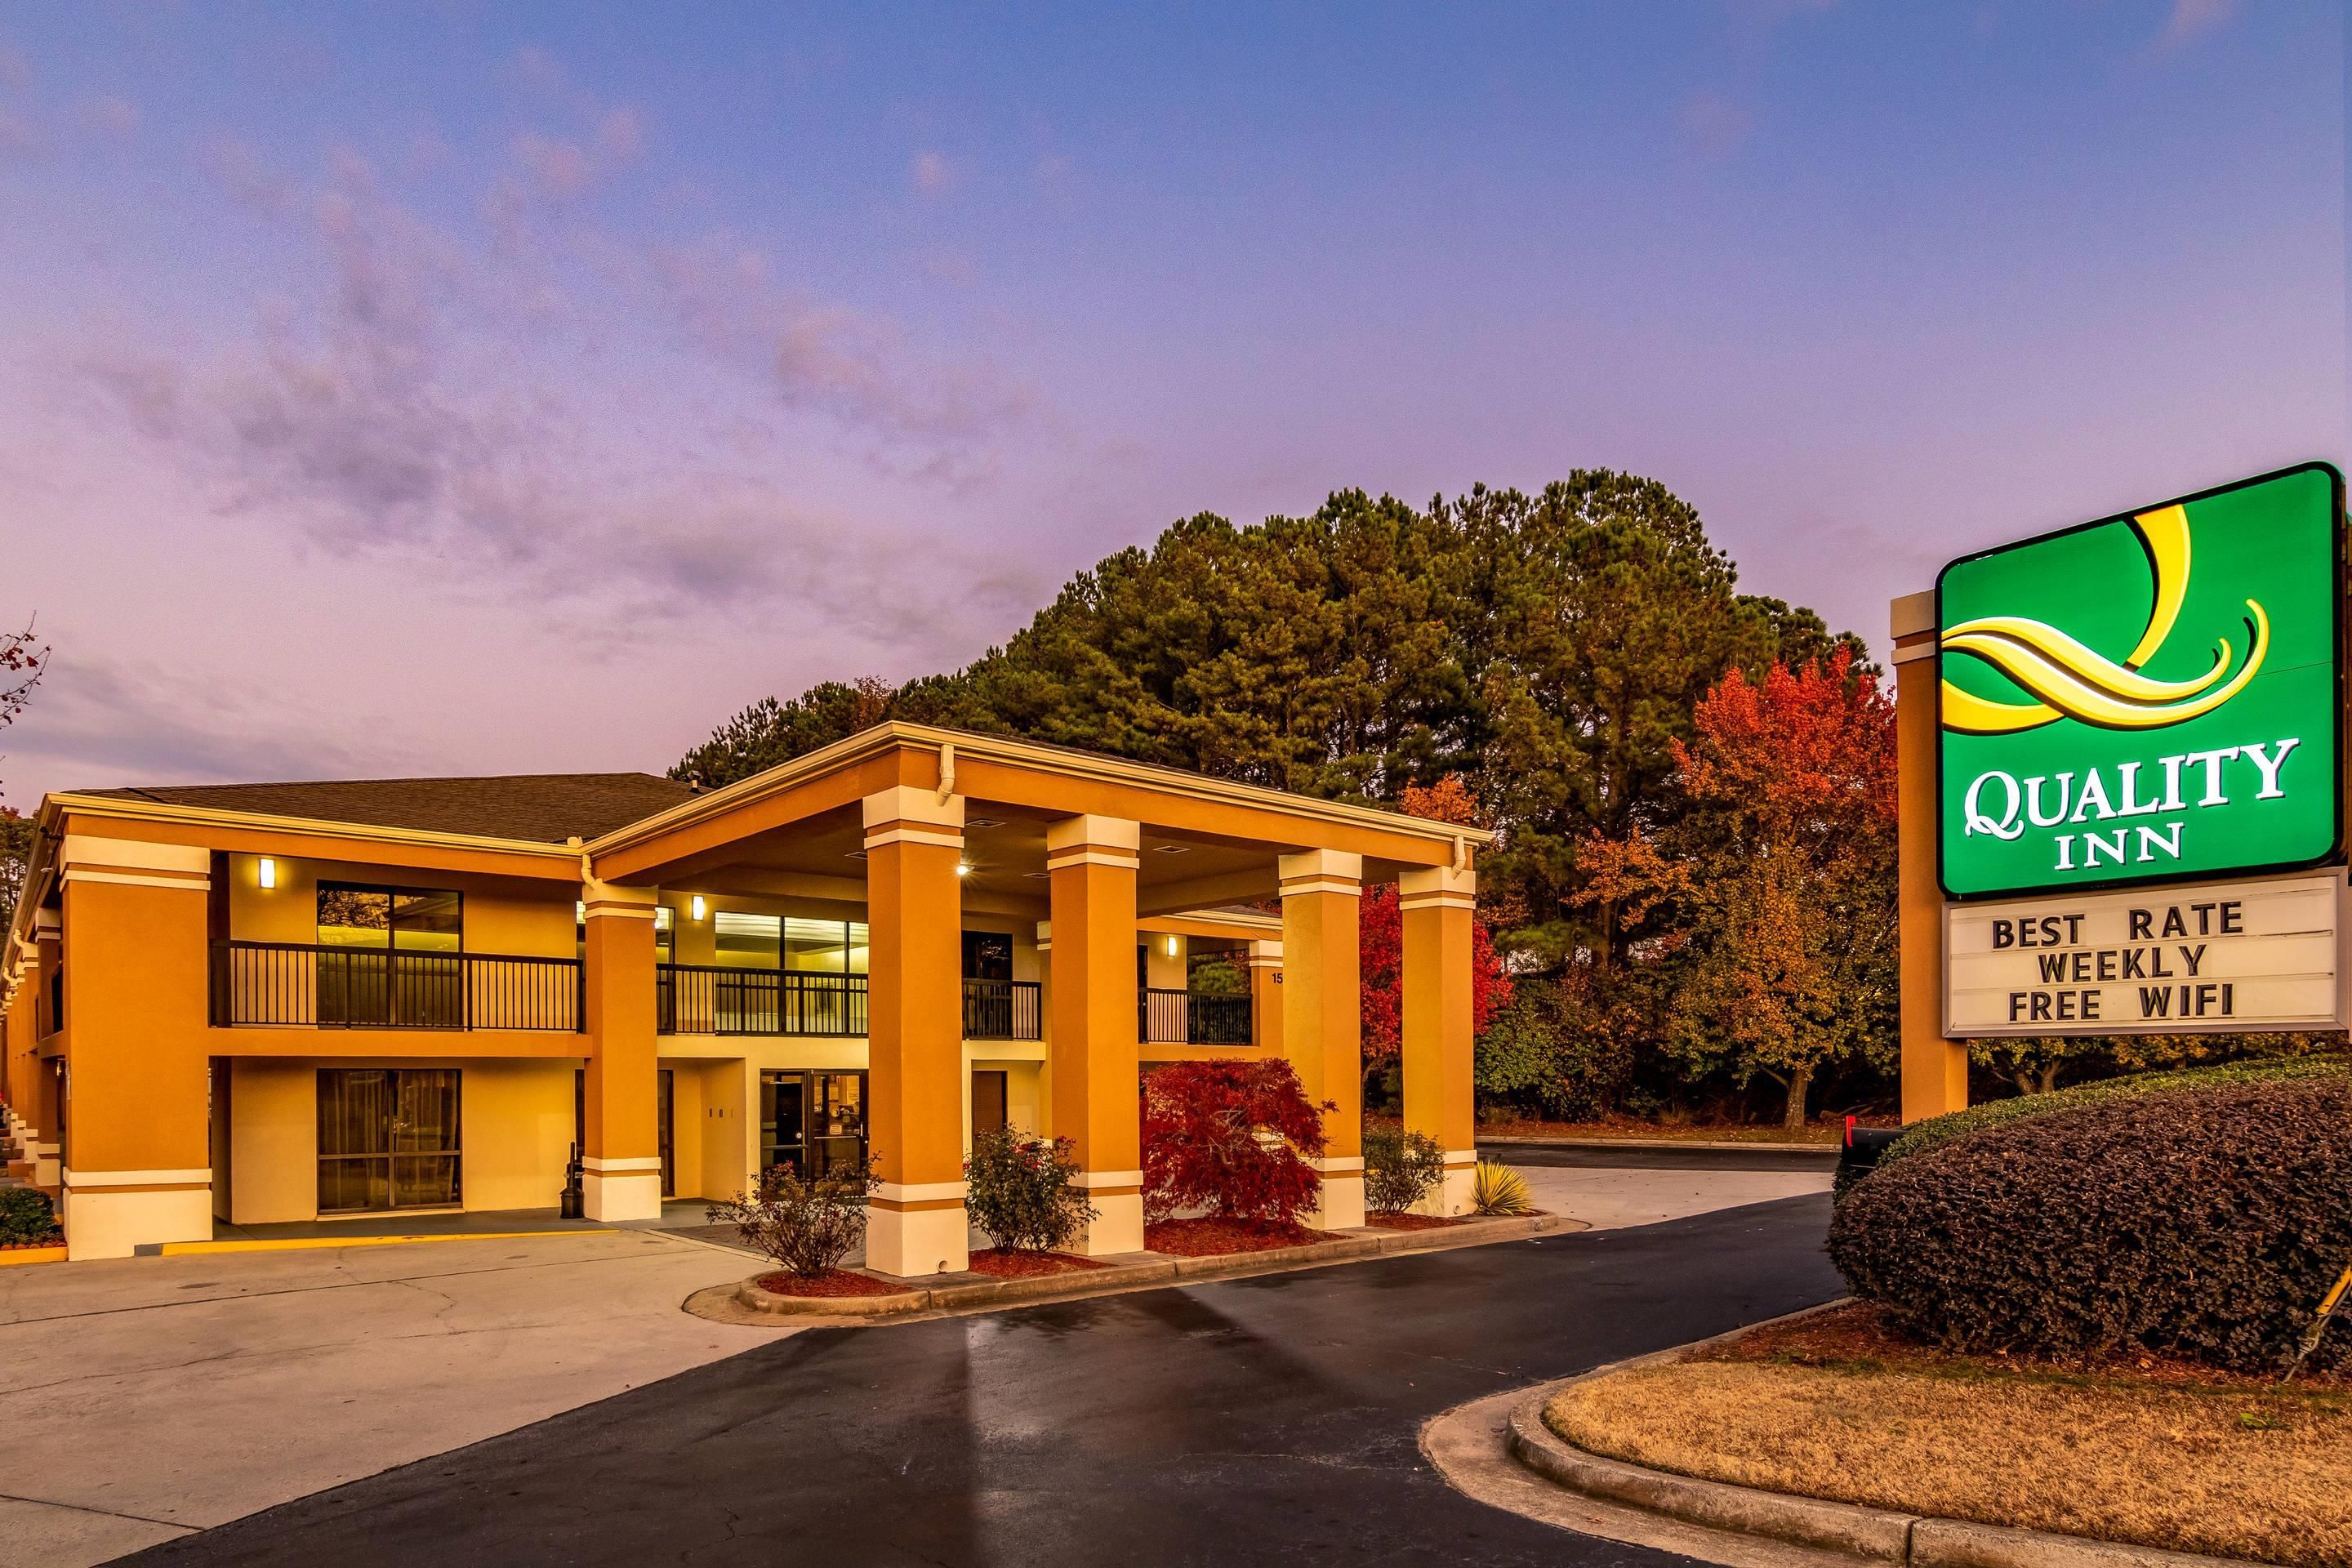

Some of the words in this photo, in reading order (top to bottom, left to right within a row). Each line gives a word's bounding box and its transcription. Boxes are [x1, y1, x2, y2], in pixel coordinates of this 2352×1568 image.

[1964, 738, 2301, 841] QUALITY
[2054, 822, 2186, 871] INN
[1992, 914, 2085, 949] BEST
[2129, 901, 2243, 940] RATE
[2038, 944, 2207, 983] WEEKLY
[2009, 989, 2101, 1022] FREE
[2138, 983, 2234, 1018] WIFI
